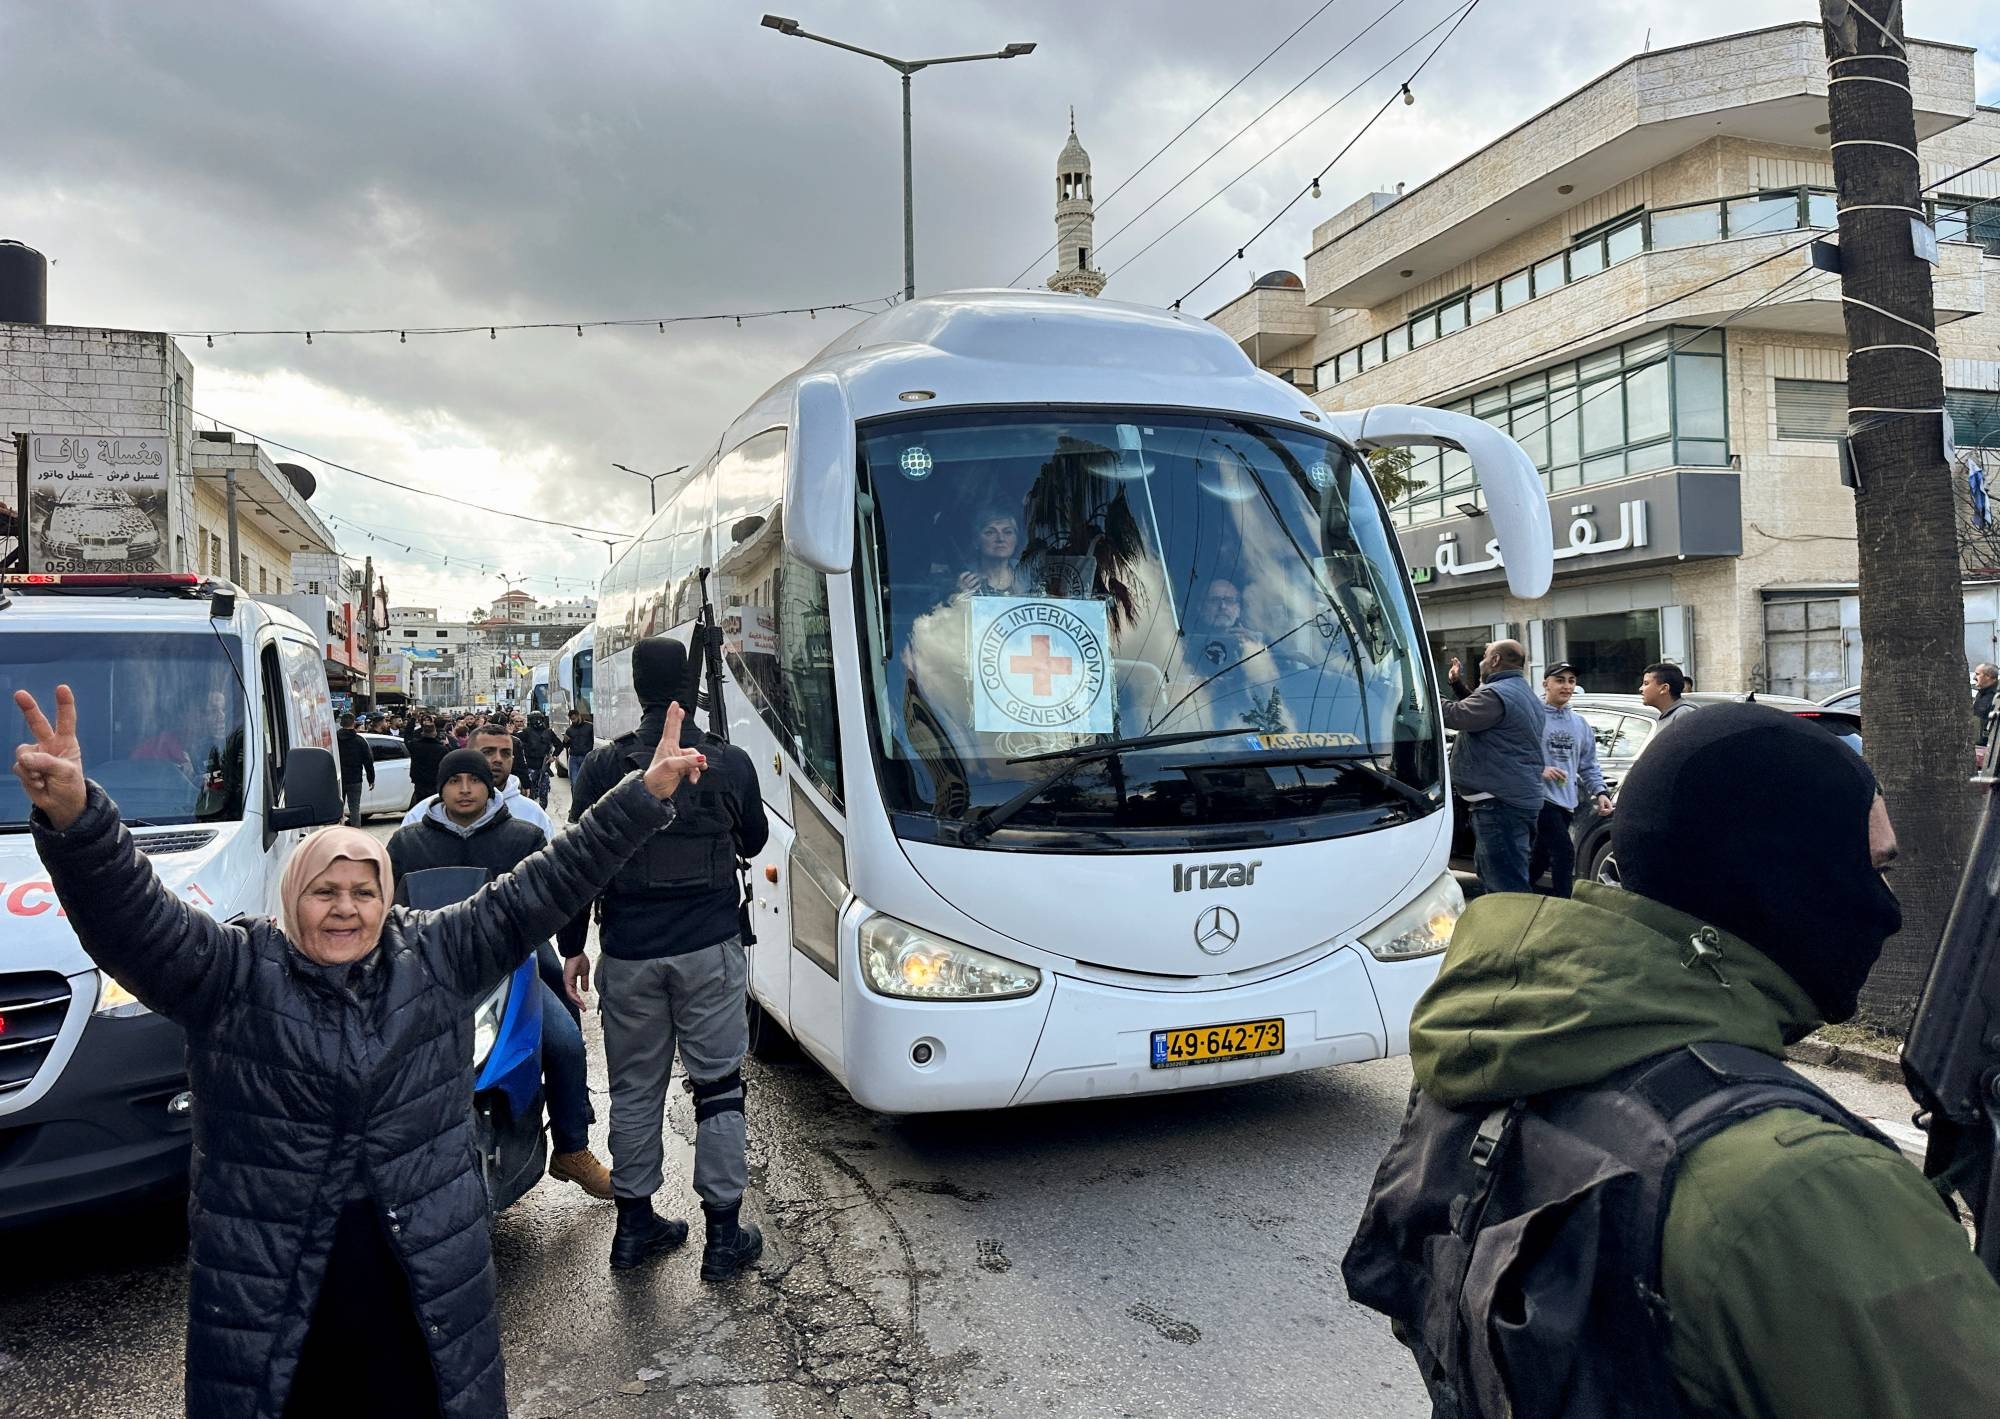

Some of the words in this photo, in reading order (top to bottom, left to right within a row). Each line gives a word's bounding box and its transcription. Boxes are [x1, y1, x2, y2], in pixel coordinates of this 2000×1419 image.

[35, 438, 89, 469] يافا
[98, 440, 162, 466] مغسلة
[38, 470, 64, 480] ماتور
[66, 471, 94, 481] غسيل
[106, 471, 130, 481] فرش
[133, 471, 160, 481] غسيل
[45, 562, 155, 573] 0599-721868
[982, 623, 1009, 690] COMITE
[1007, 606, 1101, 694] INTERNATIONAL
[1006, 700, 1080, 724] GENEVE
[1173, 860, 1262, 892] Irizar
